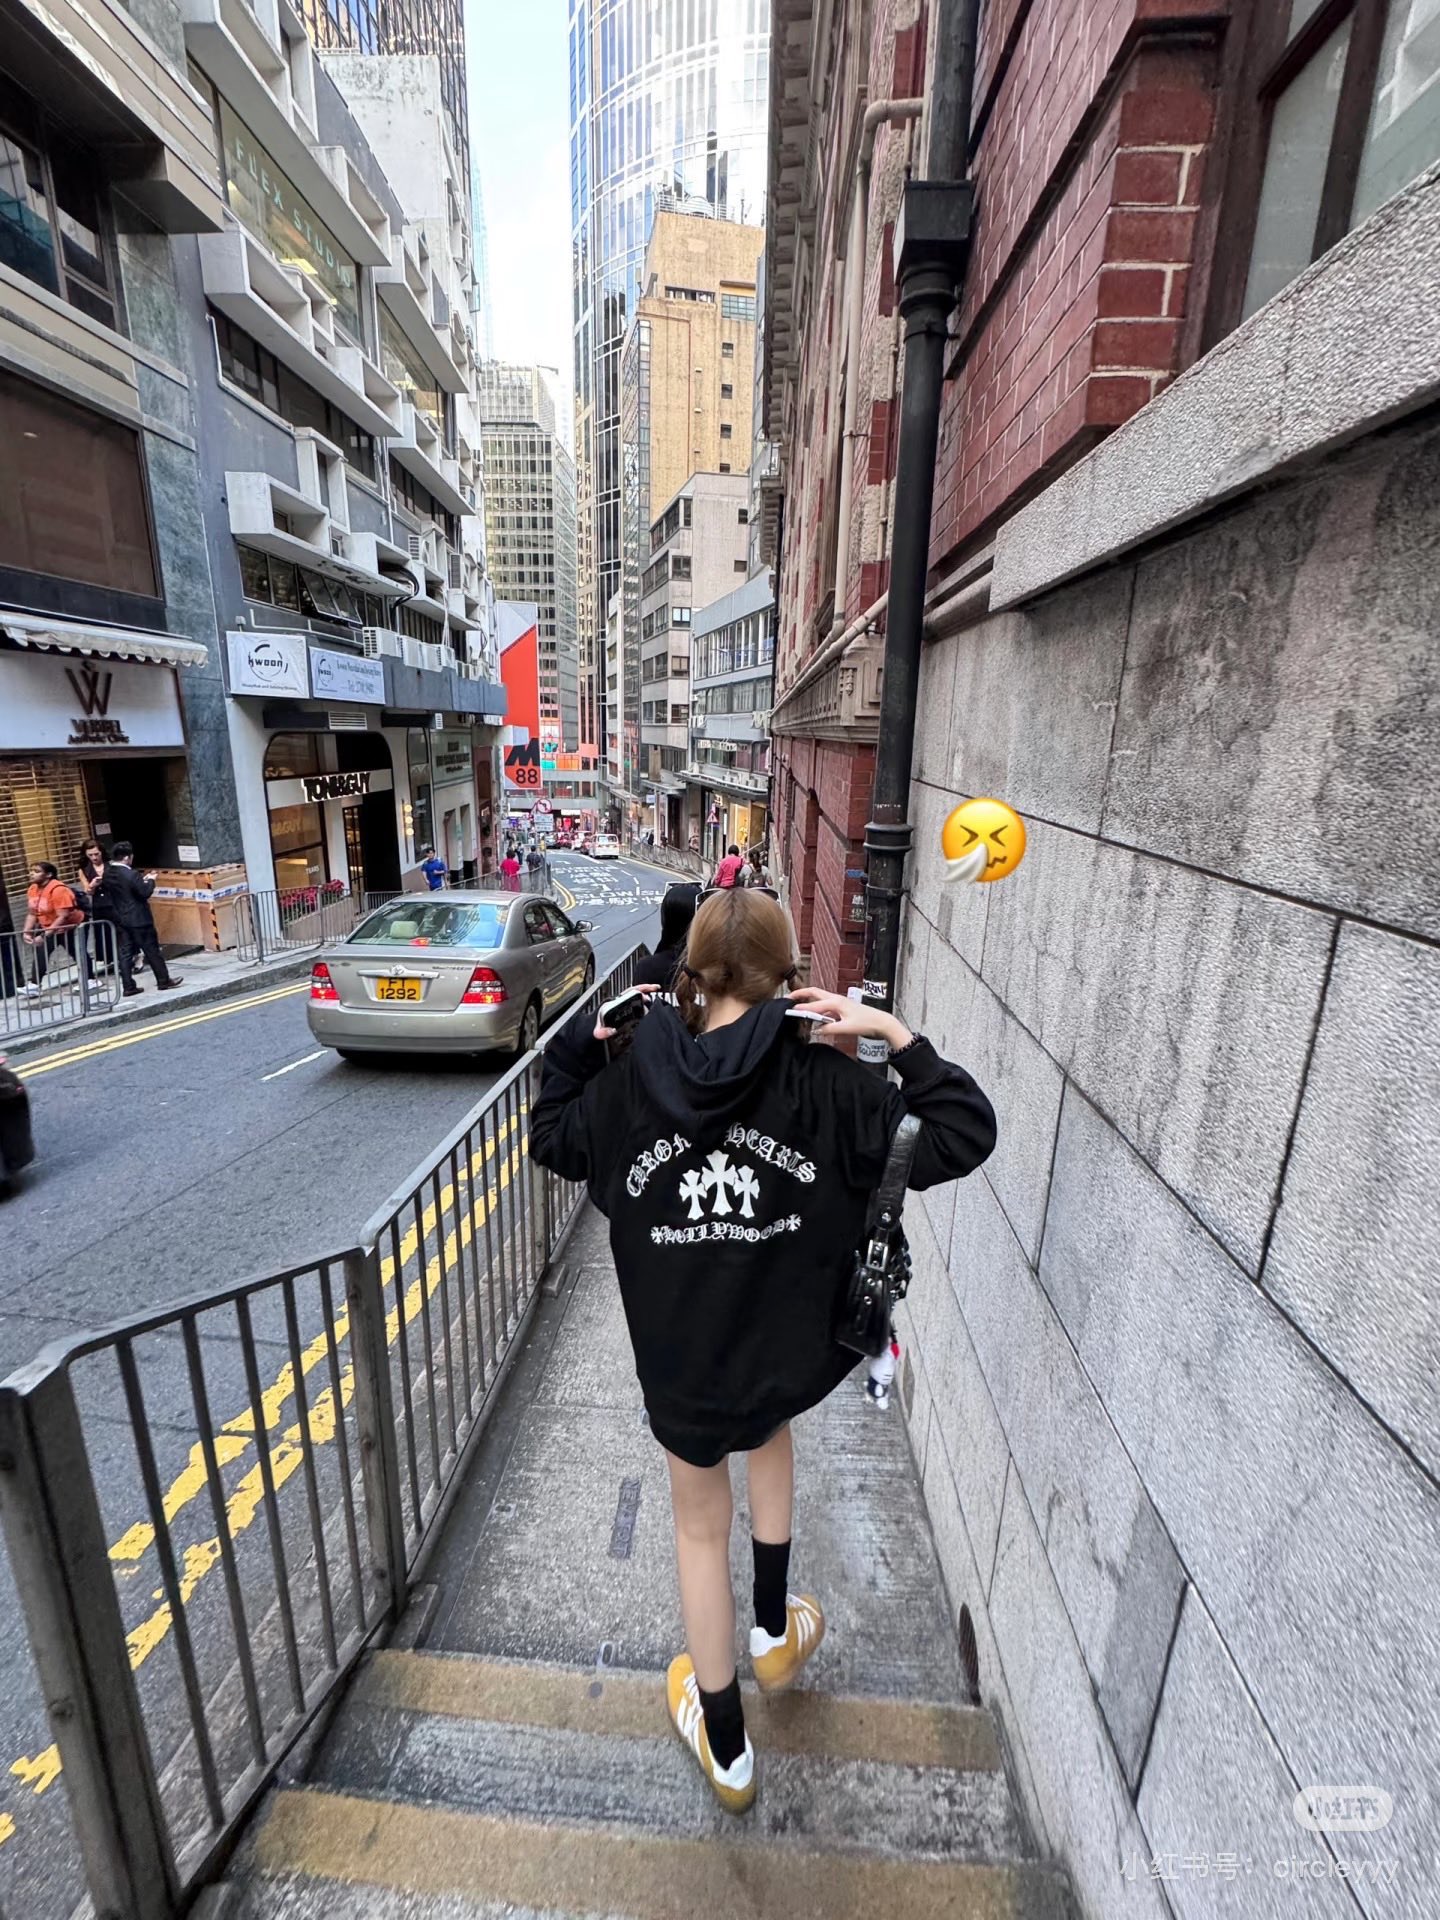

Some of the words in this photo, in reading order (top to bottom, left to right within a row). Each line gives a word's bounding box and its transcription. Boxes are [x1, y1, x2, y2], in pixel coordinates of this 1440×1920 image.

[235, 138, 284, 211] FLEX
[293, 208, 351, 288] STUDIO
[248, 652, 283, 668] kwoon
[515, 768, 538, 784] 88
[301, 771, 371, 803] TONI&GUY
[575, 890, 633, 899] SLOW
[388, 978, 407, 989] FT
[380, 988, 417, 1000] 1292
[723, 1122, 817, 1183] HEARTS
[663, 1219, 786, 1245] HOLLYWOOD
